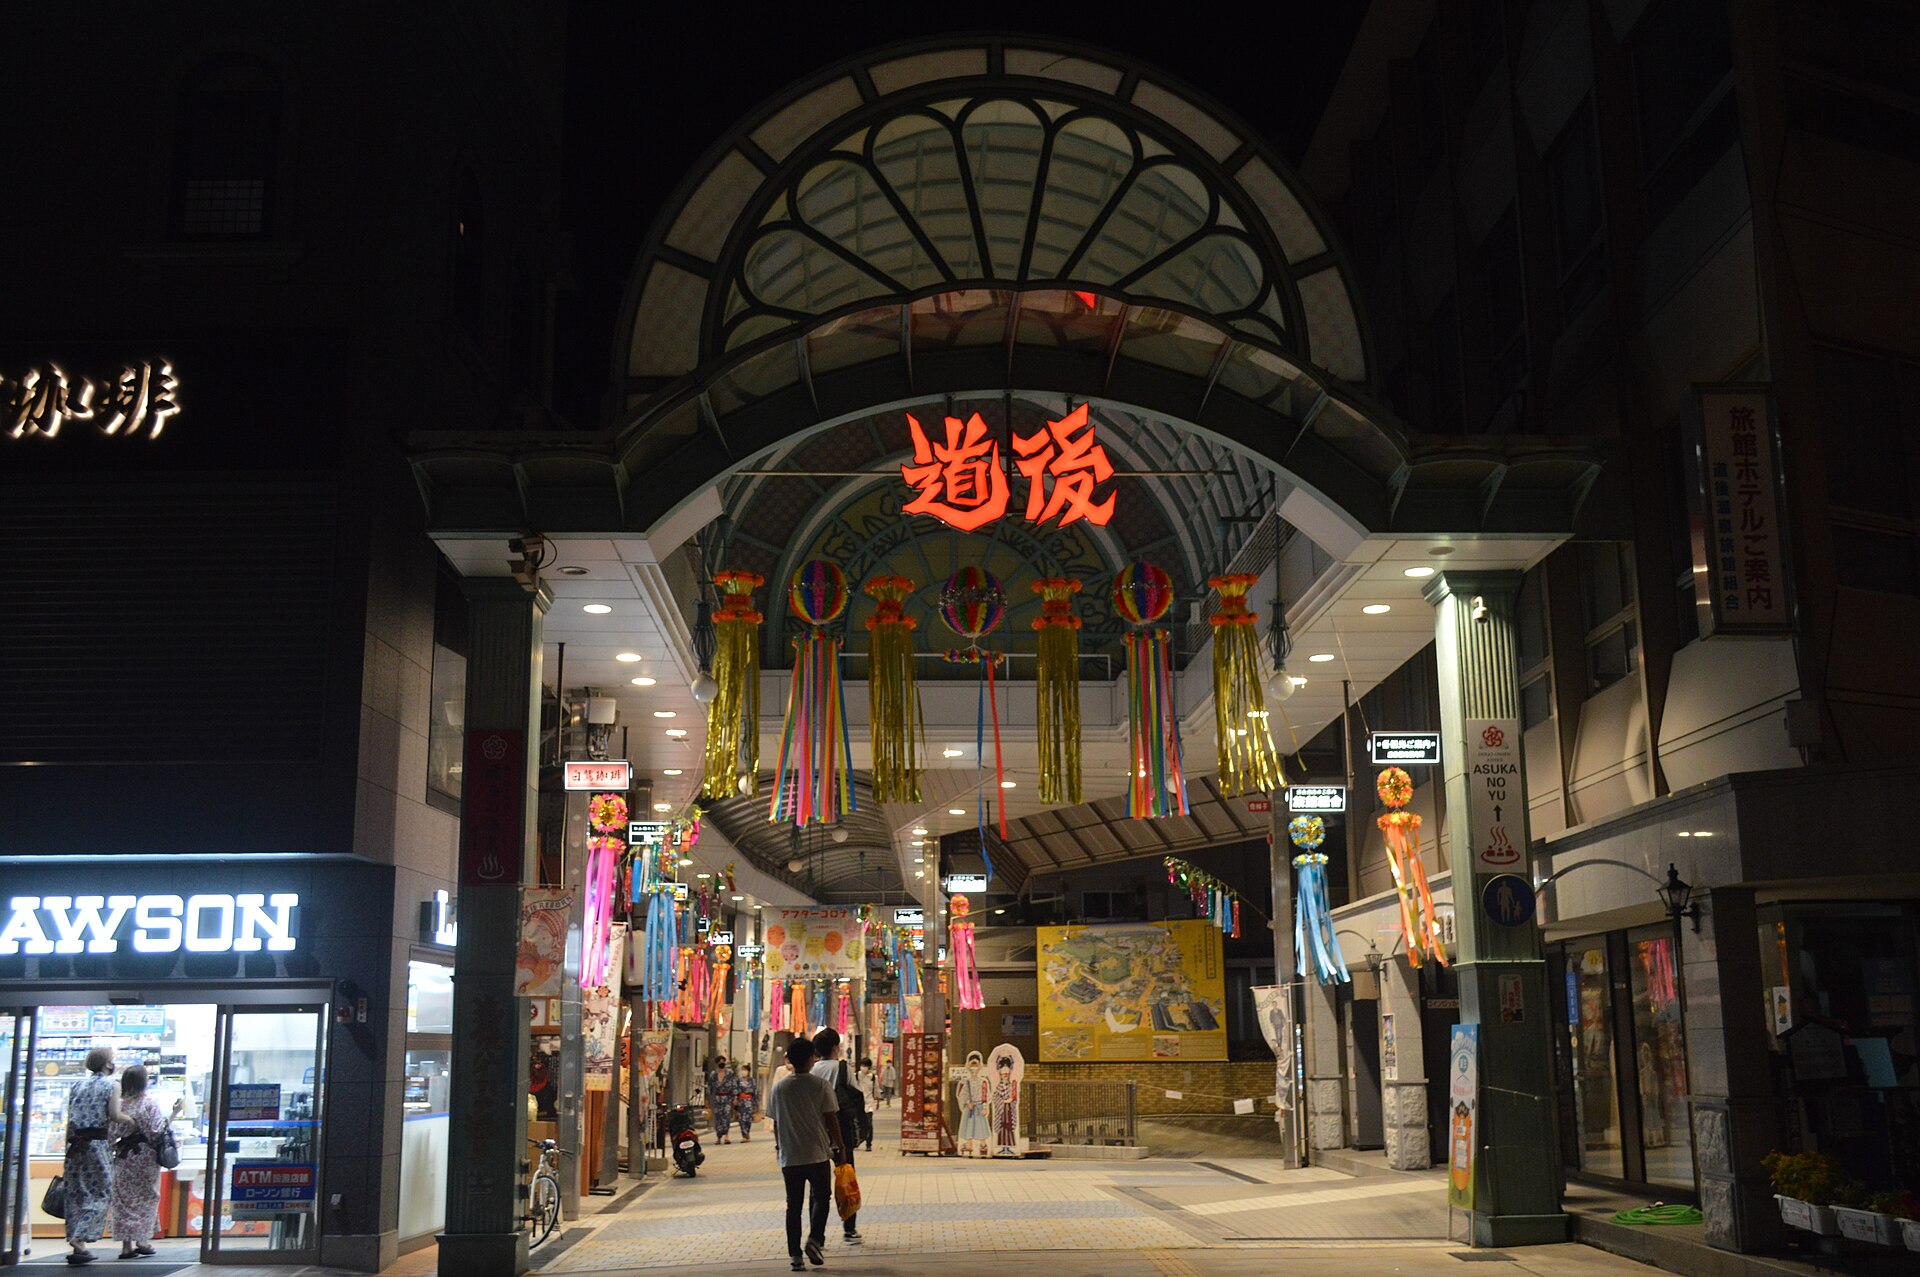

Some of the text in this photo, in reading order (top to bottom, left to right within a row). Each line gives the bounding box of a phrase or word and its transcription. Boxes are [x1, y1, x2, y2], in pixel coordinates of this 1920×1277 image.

[0, 357, 183, 440] 珈琲
[901, 403, 1117, 531] 道後
[1730, 406, 1773, 611] 旅館ホテルご案内
[1712, 462, 1739, 611] 道後温泉旅館組合
[1473, 764, 1518, 775] ASUKA
[1487, 777, 1506, 788] NO
[1488, 790, 1506, 801] YU
[0, 893, 300, 955] AWSON
[780, 909, 849, 919] アフターコロナ
[245, 1187, 302, 1198] ローソン銀行
